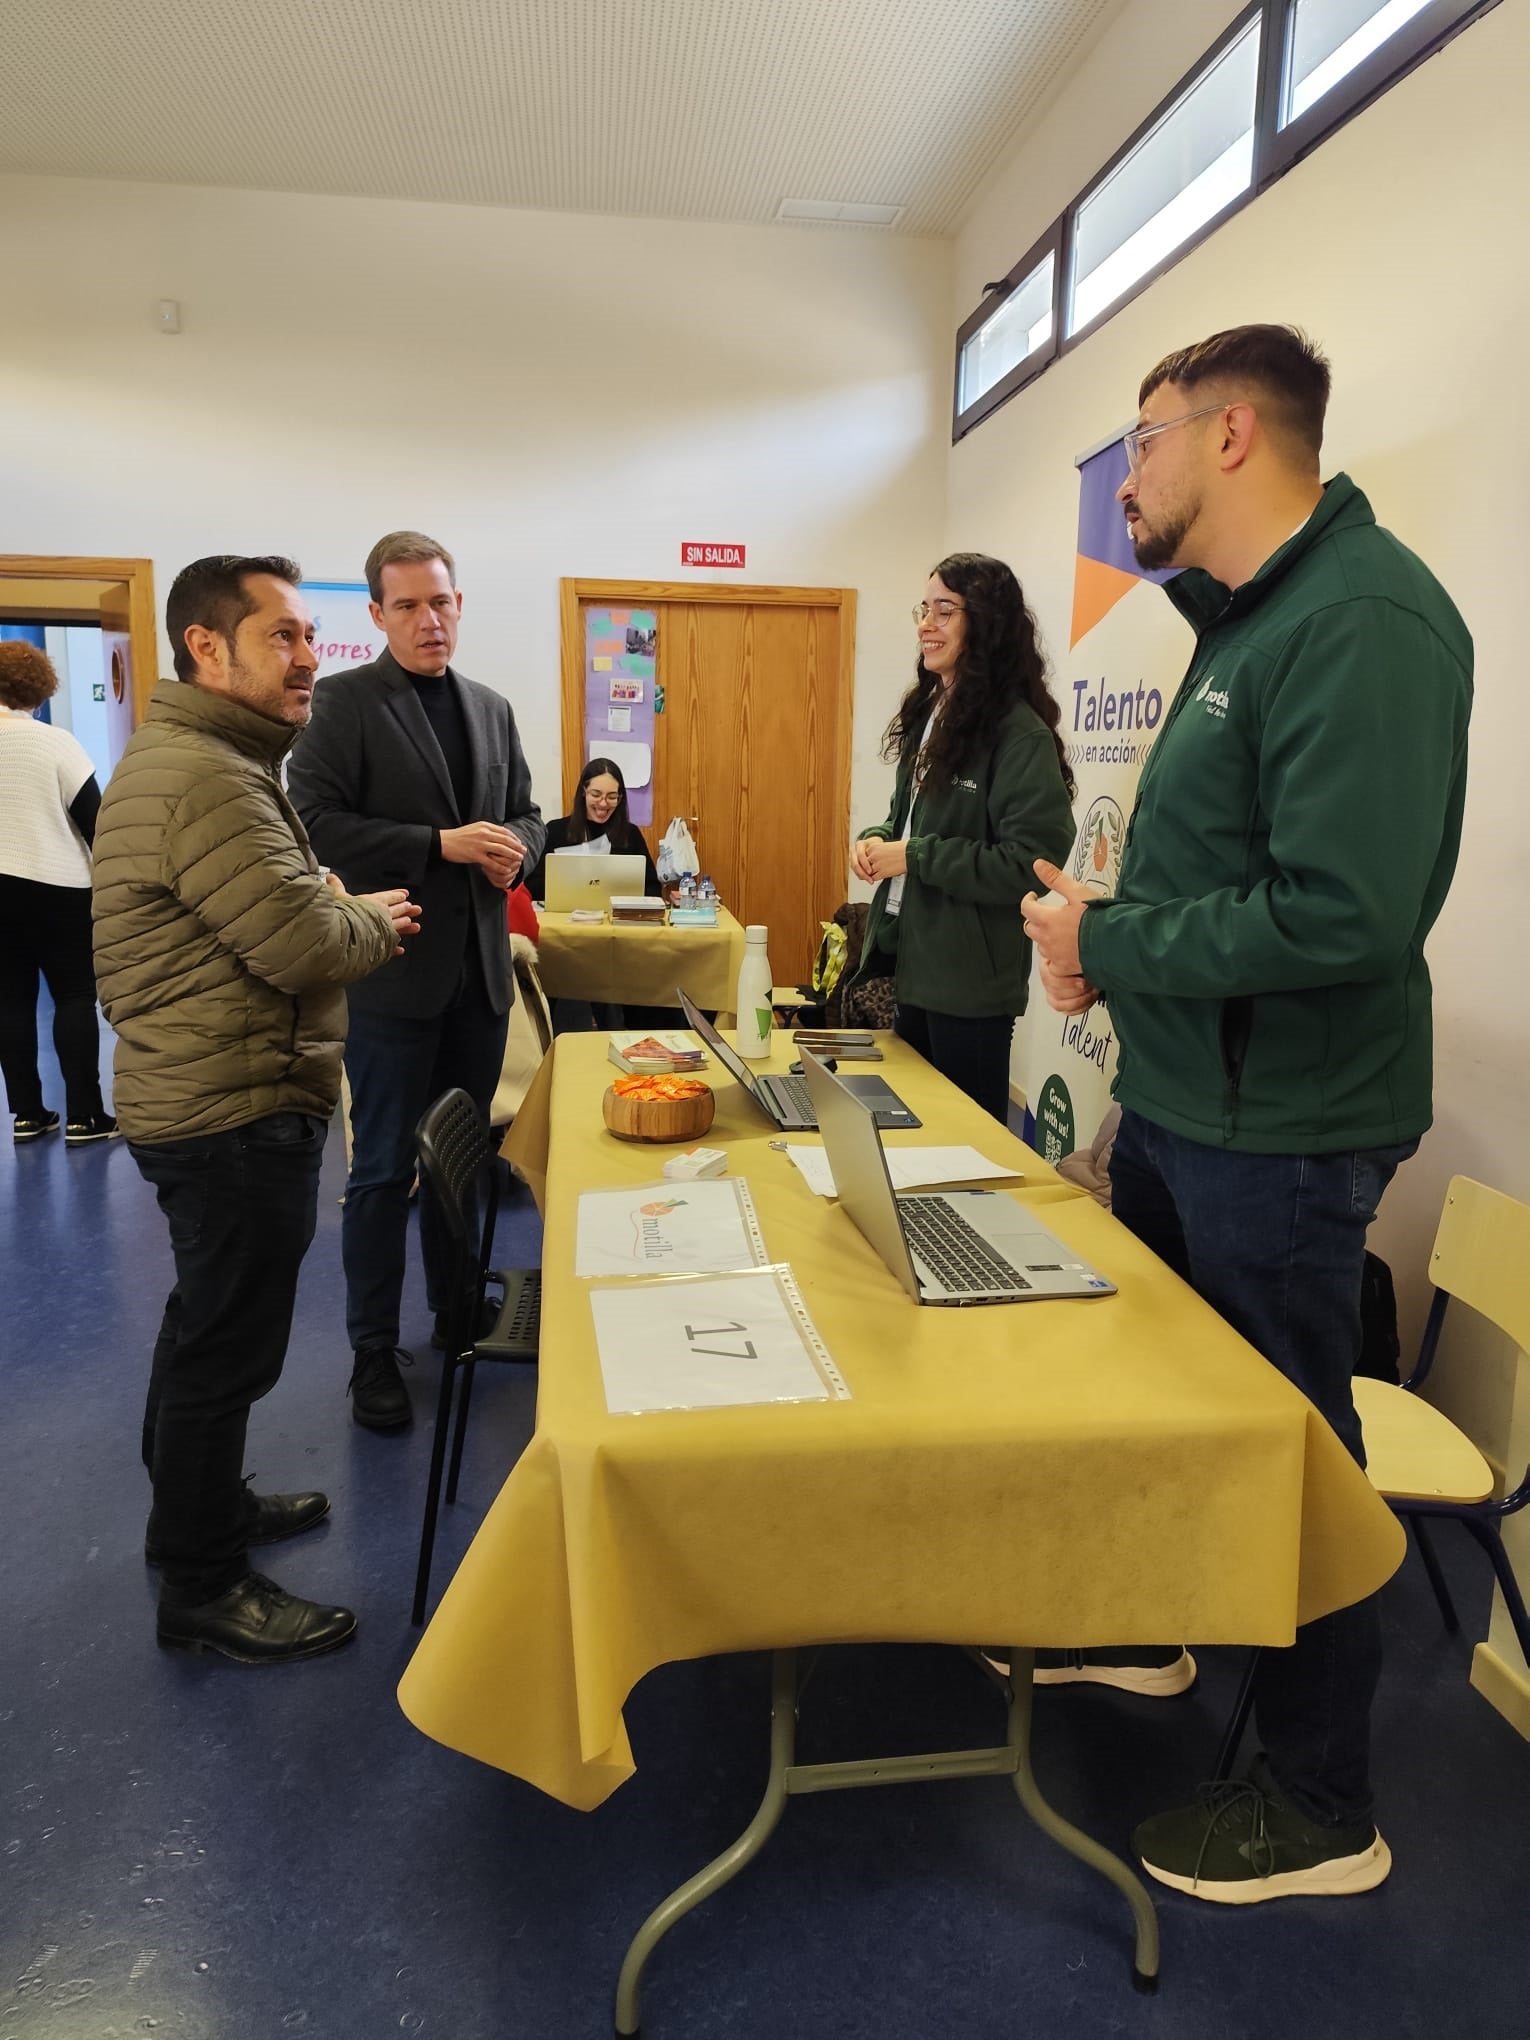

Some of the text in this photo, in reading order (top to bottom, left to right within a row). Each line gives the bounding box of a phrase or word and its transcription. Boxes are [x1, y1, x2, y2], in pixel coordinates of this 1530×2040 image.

[686, 546, 741, 564] SIN SALIDA
[311, 641, 372, 661] yores
[1073, 676, 1163, 732] Talento
[1085, 738, 1136, 763] en acción
[1049, 1087, 1067, 1114] Grow
[1043, 1108, 1069, 1139] with us!
[642, 1218, 673, 1259] motilla
[684, 1321, 758, 1359] 17
